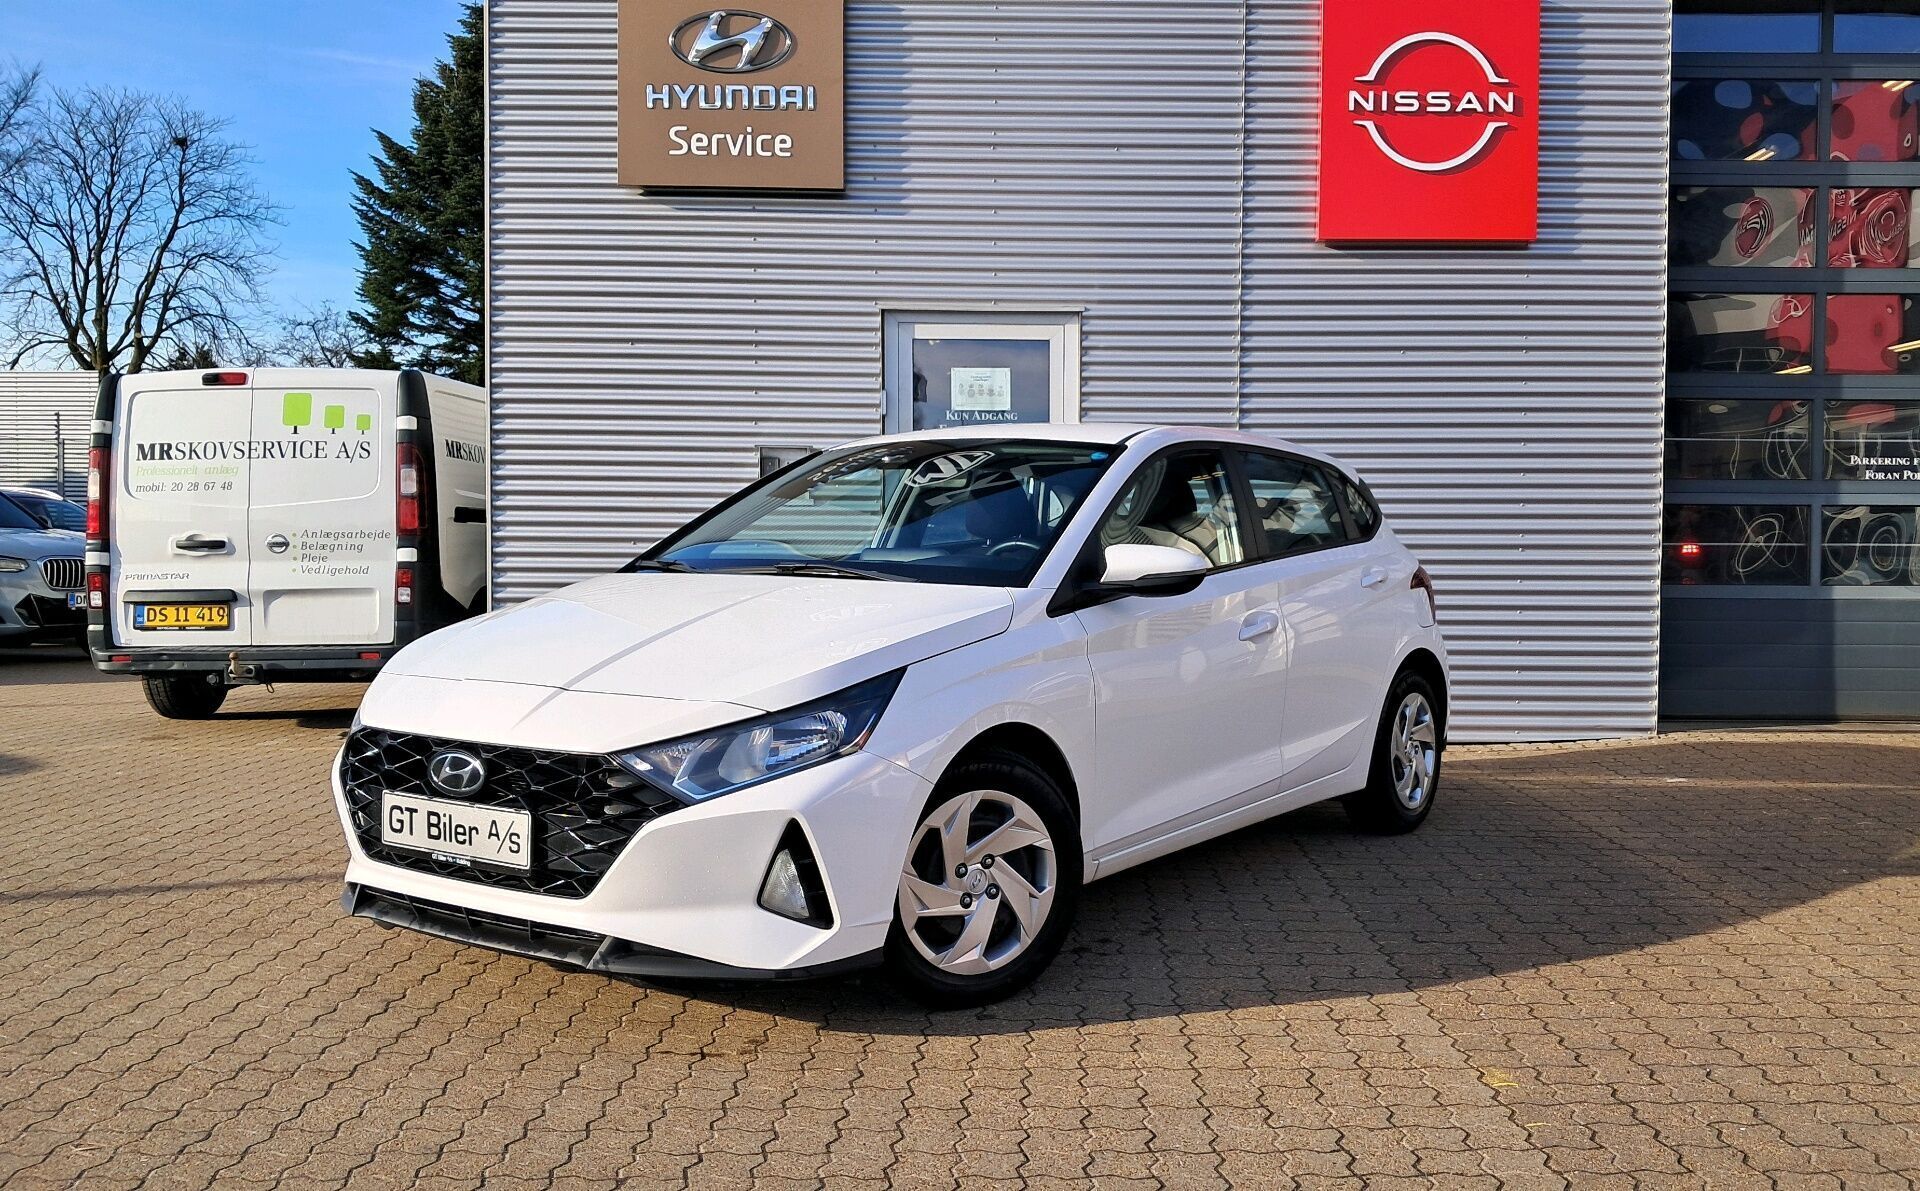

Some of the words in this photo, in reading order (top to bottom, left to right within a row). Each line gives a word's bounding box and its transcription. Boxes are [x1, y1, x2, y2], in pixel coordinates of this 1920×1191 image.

[646, 84, 815, 111] HYUNDAI
[1349, 90, 1514, 113] NISSAN
[668, 126, 792, 157] Service
[136, 440, 328, 461] MRSKOVSERVICE
[335, 440, 371, 463] A/S
[135, 482, 166, 493] mobil:
[171, 482, 183, 491] 20
[187, 482, 199, 491] 28
[204, 481, 216, 491] 67
[220, 481, 233, 490] 48
[300, 529, 391, 540] Anlægsarbejde
[300, 541, 364, 553] Belægning
[300, 553, 328, 563] Pleje
[300, 565, 370, 576] Vedligehold
[146, 607, 168, 622] DS
[174, 607, 190, 622] 11
[195, 606, 226, 622] 419
[389, 804, 418, 836] GT
[426, 810, 479, 846] Biler
[488, 819, 521, 854] A/S
